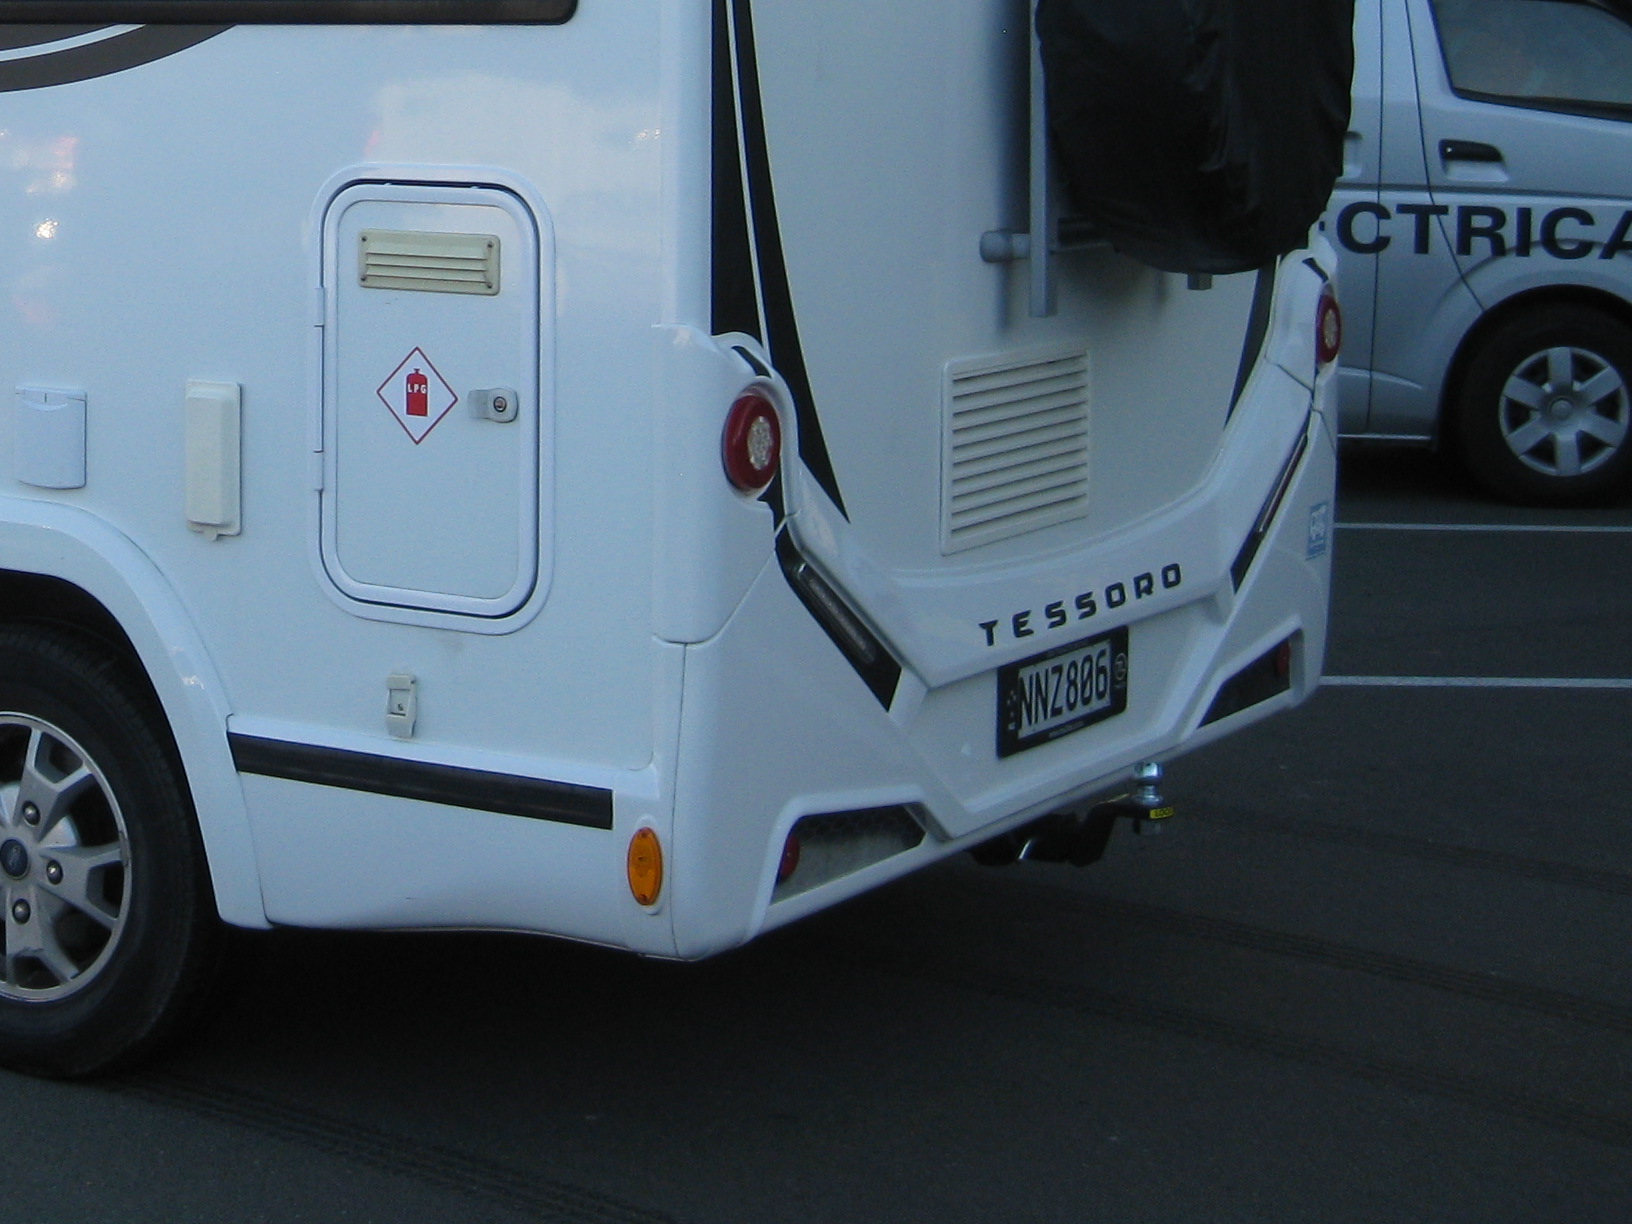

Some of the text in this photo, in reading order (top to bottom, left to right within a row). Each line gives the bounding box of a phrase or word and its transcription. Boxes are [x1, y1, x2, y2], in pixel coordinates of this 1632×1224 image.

[1333, 200, 1632, 260] CTRICA
[407, 383, 428, 394] LPG
[978, 562, 1183, 647] TESSORO
[1018, 648, 1108, 730] NNZ806
